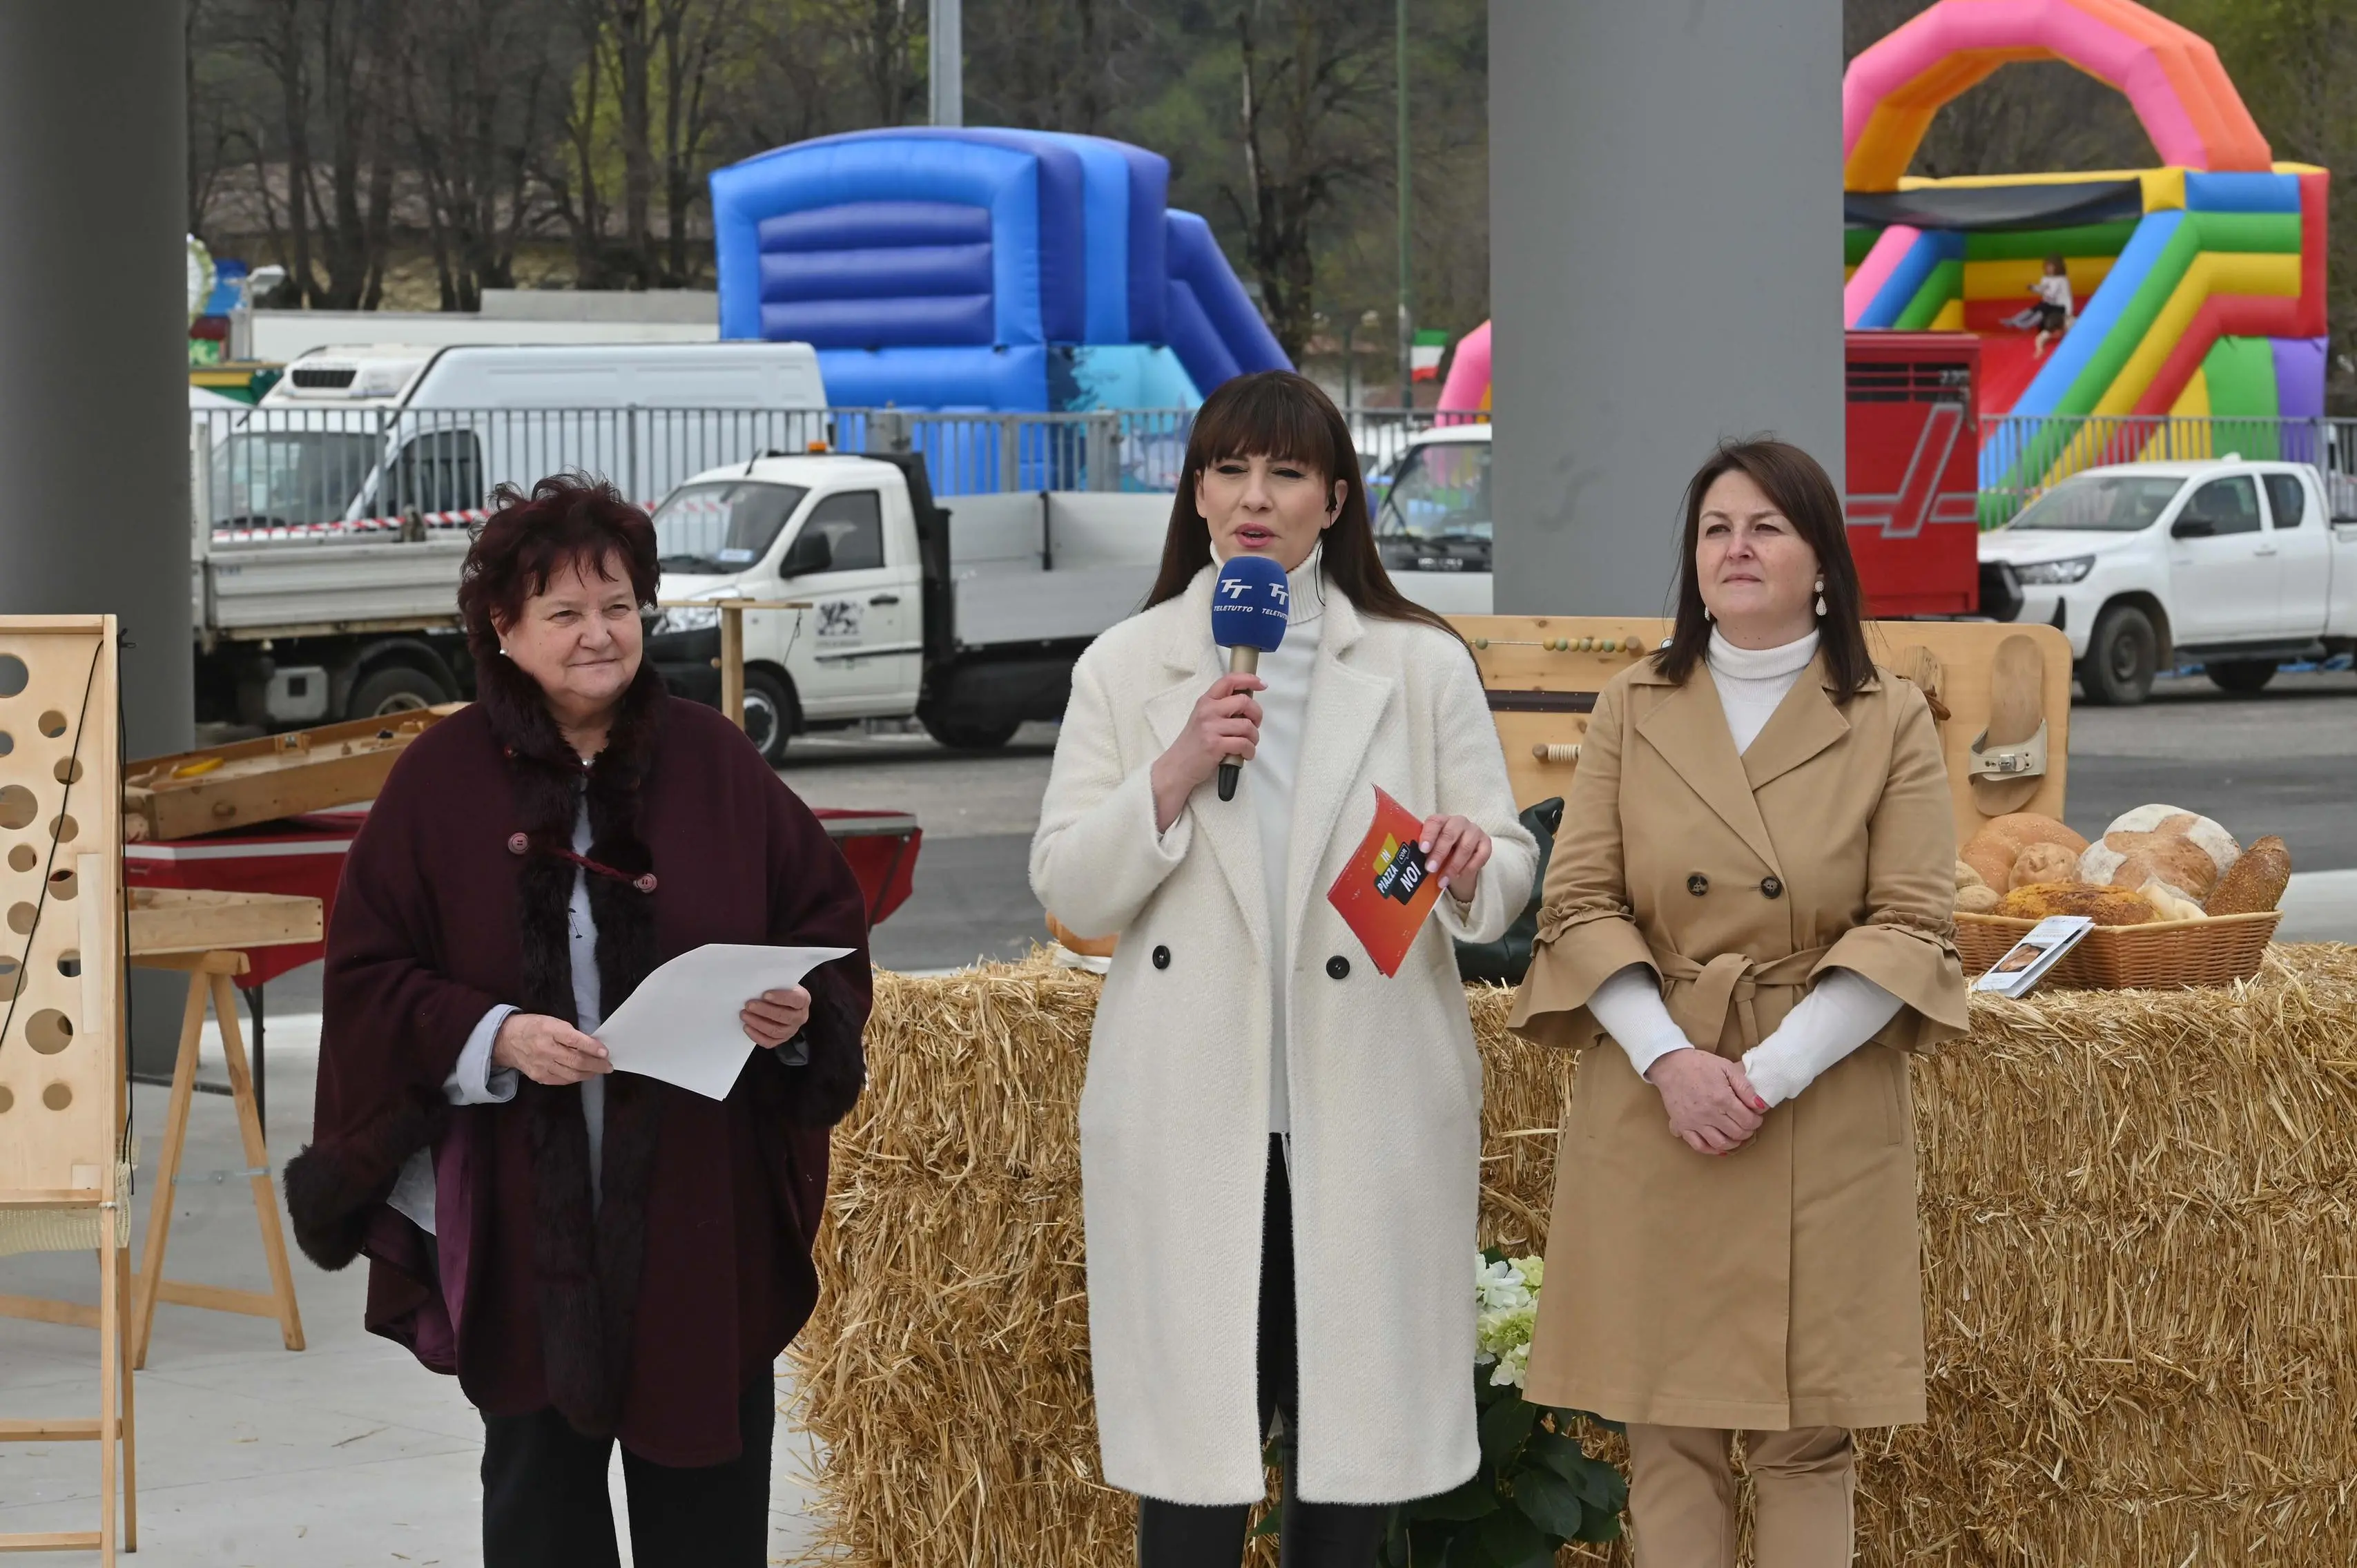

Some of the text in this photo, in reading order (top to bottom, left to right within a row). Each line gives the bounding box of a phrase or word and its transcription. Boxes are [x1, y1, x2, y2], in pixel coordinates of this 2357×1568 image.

[1261, 608, 1288, 620] TELETUT
[1380, 849, 1392, 863] IN
[1398, 848, 1408, 860] con
[1377, 864, 1399, 894] PIAZZA
[1399, 860, 1422, 893] NOI
